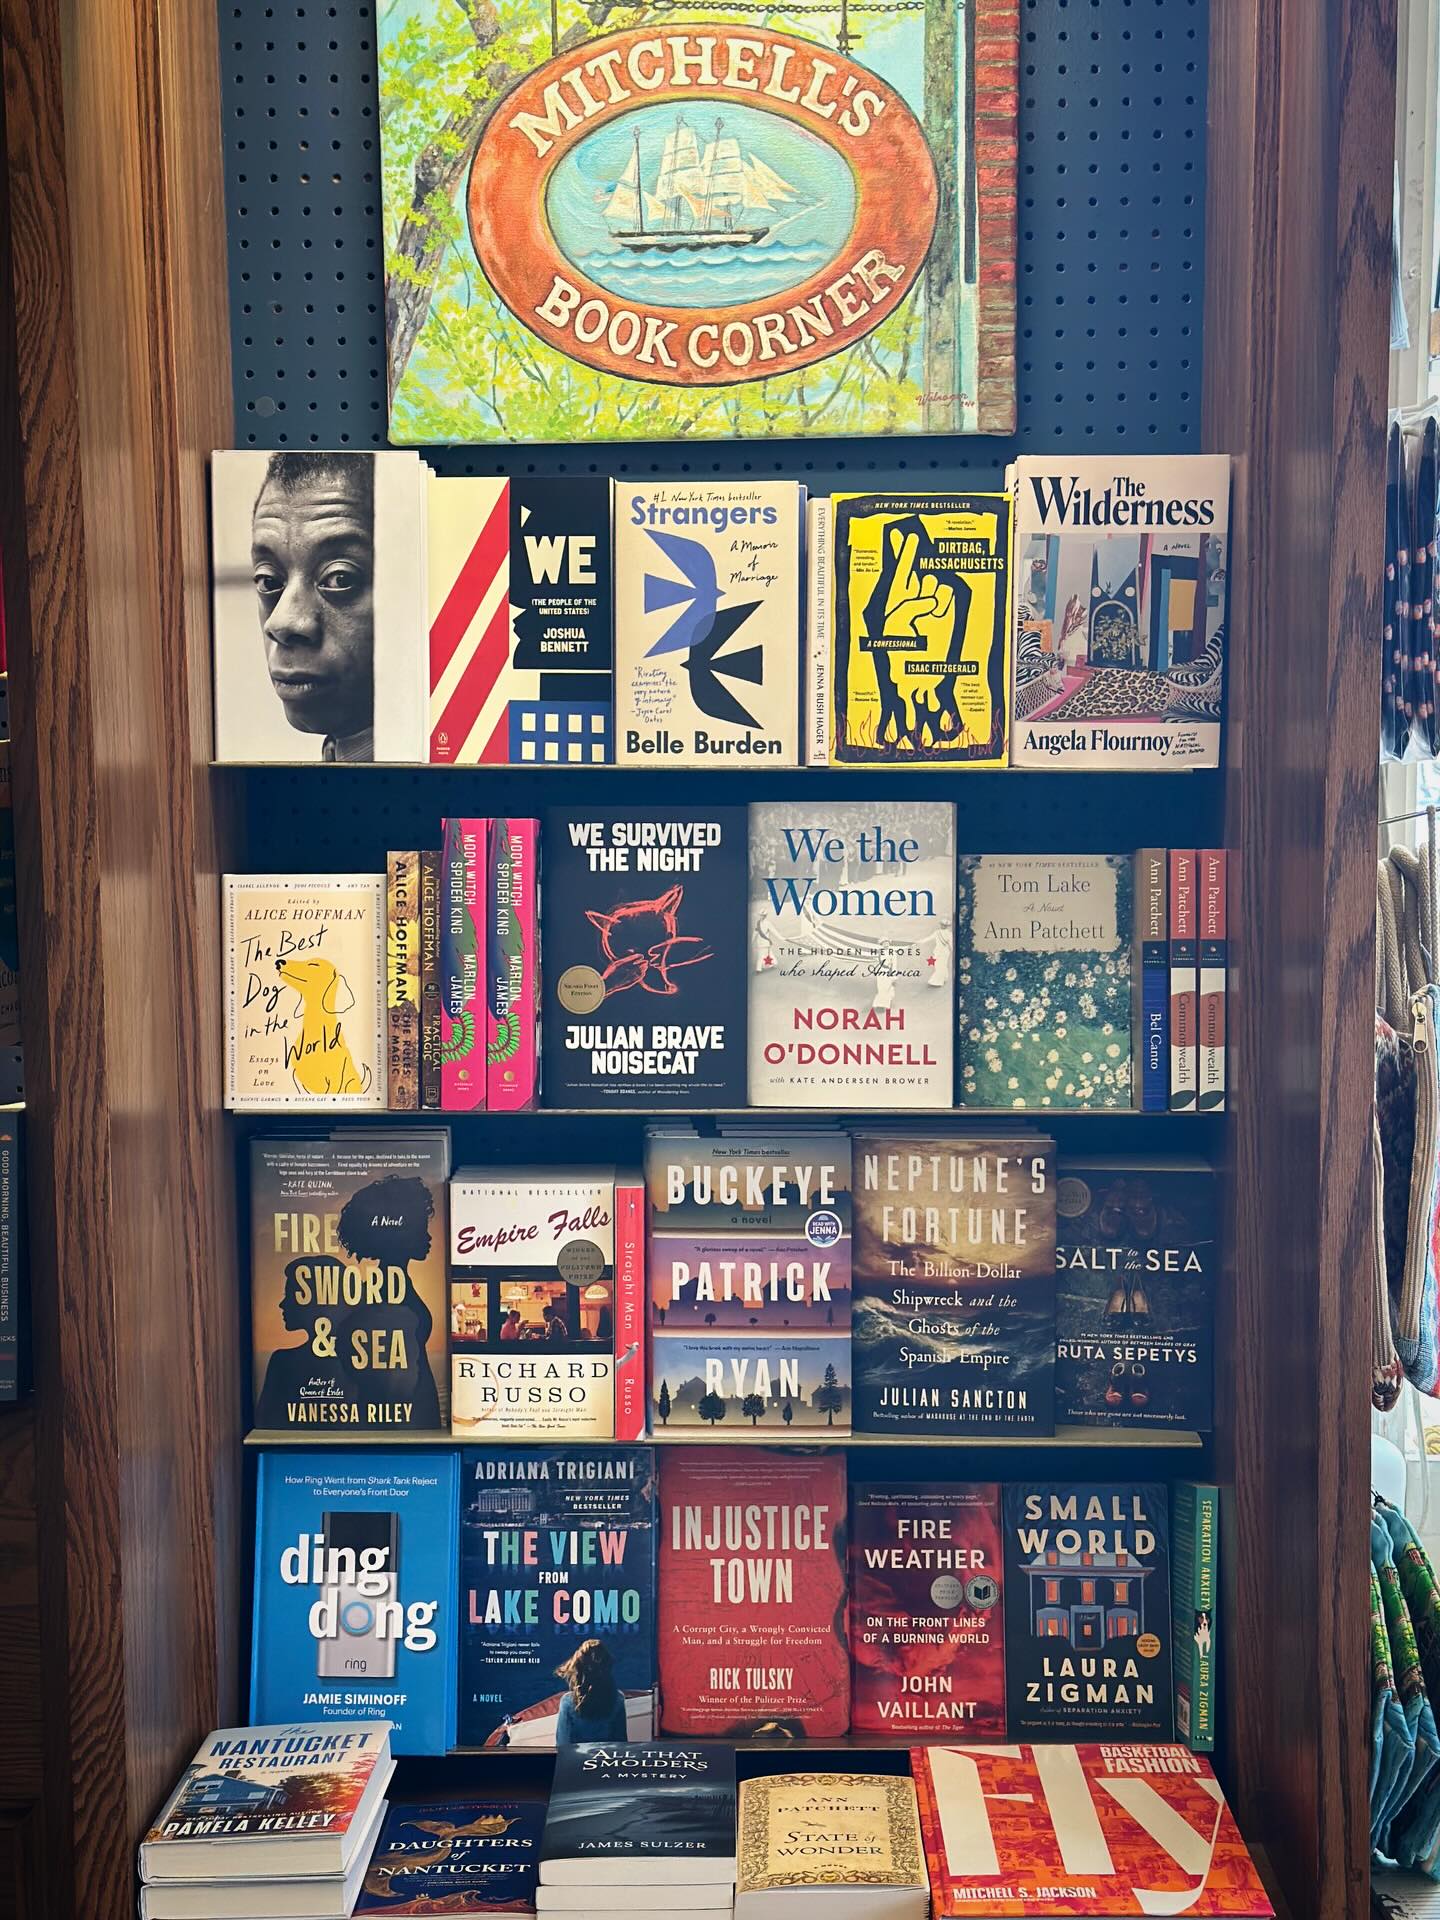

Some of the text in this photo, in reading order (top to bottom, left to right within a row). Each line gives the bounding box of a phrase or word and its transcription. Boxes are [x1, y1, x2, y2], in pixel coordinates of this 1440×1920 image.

[508, 36, 887, 159] MITCHELL'S
[534, 249, 907, 368] BOOK CORNER
[1113, 477, 1145, 496] The
[1029, 477, 1214, 525] Wilderness
[631, 496, 778, 533] Strangers
[524, 536, 596, 584] WE
[939, 542, 985, 555] DIRTBAG,
[920, 558, 1003, 570] MASSACHUSETTS
[543, 628, 585, 639] JOSHUA
[540, 641, 589, 652] BENNETT
[908, 664, 976, 673] ISAAC FITZGERALD
[816, 713, 824, 744] HAGER
[626, 731, 782, 754] Belle Burden
[1024, 729, 1173, 756] Angela Flournoy
[568, 823, 721, 847] WE SURVIVED
[781, 826, 919, 863] We the
[464, 834, 476, 905] MOON WITCH
[586, 848, 704, 871] THE NIGHT
[998, 874, 1090, 893] Tom Lake
[451, 862, 462, 933] SPIDER KING
[763, 878, 936, 916] Women
[245, 909, 366, 920] ALICE HOFFMAN
[984, 920, 1105, 939] Ann Patchett
[240, 924, 328, 967] The Best
[870, 948, 921, 956] HEROES
[243, 974, 287, 1012] Dog
[245, 1014, 288, 1038] in the
[794, 1008, 904, 1030] NORAH
[284, 1022, 341, 1069] World
[565, 1026, 725, 1049] JULIAN BRAVE
[1150, 1013, 1162, 1070] Bel Canto
[591, 1051, 699, 1075] NOISECAT
[764, 1043, 936, 1065] O'DONNELL
[667, 1165, 835, 1206] BUCKEYE
[864, 1155, 1045, 1194] NEPTUNE'S
[274, 1213, 339, 1253] FIRE
[457, 1206, 611, 1254] Empire Falls
[882, 1206, 1027, 1245] FORTUNE
[888, 1260, 1022, 1279] The Billion-Dollar
[1056, 1247, 1122, 1270] SALT
[1124, 1262, 1141, 1270] the
[1146, 1250, 1202, 1272] SEA
[295, 1266, 406, 1306] SWORD
[623, 1242, 635, 1328] Straight Man
[672, 1262, 832, 1302] PATRICK
[892, 1289, 1017, 1311] Shipwreck and the
[312, 1317, 337, 1358] &
[908, 1319, 1000, 1337] Ghosts of the
[352, 1329, 408, 1370] SEA
[900, 1347, 1010, 1370] Spanish Empire
[1058, 1346, 1197, 1362] RUTA SEPETYS
[459, 1363, 608, 1378] RICHARD
[706, 1358, 799, 1398] RYAN
[482, 1387, 586, 1403] RUSSO
[624, 1379, 634, 1415] Russo
[881, 1387, 1027, 1409] JULIAN SANCTON
[287, 1403, 412, 1423] VANESSA RILEY
[475, 1462, 634, 1480] ADRIANA TRIGIANI
[323, 1488, 366, 1496] Everyone's
[367, 1488, 388, 1496] Front
[1025, 1495, 1147, 1521] SMALL
[672, 1505, 829, 1550] INJUSTICE
[898, 1520, 952, 1539] FIRE
[484, 1531, 627, 1565] THE VIEW
[1017, 1529, 1156, 1555] WORLD
[280, 1534, 389, 1597] ding
[864, 1549, 985, 1569] WEATHER
[539, 1572, 569, 1583] FROM
[710, 1558, 793, 1605] TOWN
[469, 1589, 640, 1624] LAKE COMO
[867, 1618, 985, 1628] ON THE FRONT LINES
[863, 1633, 989, 1644] OF A BURNING WORLD
[710, 1668, 793, 1690] RICK TULSKY
[1043, 1657, 1139, 1678] LAURA
[901, 1676, 952, 1693] JOHN
[1026, 1683, 1154, 1704] ZIGMAN
[303, 1693, 407, 1705] JAMIE SIMINOFF
[877, 1701, 977, 1718] VAILLANT
[209, 1733, 373, 1757] NANTUCKET
[593, 1750, 702, 1760] ALL THAT
[219, 1752, 347, 1769] RESTAURANT
[583, 1760, 708, 1772] SMOLDERS
[1105, 1757, 1201, 1774] FASHION
[163, 1819, 249, 1836] PAMELA
[258, 1813, 337, 1831] KELLEY
[389, 1839, 533, 1850] DAUGHTERS
[450, 1851, 470, 1860] of
[578, 1841, 706, 1849] JAMES SULZER
[777, 1847, 883, 1856] WONDER
[378, 1864, 531, 1876] NANTUCKET
[953, 1887, 1013, 1899] MITCHELL
[1019, 1887, 1033, 1898] S.
[1037, 1887, 1096, 1898] JACKSON
